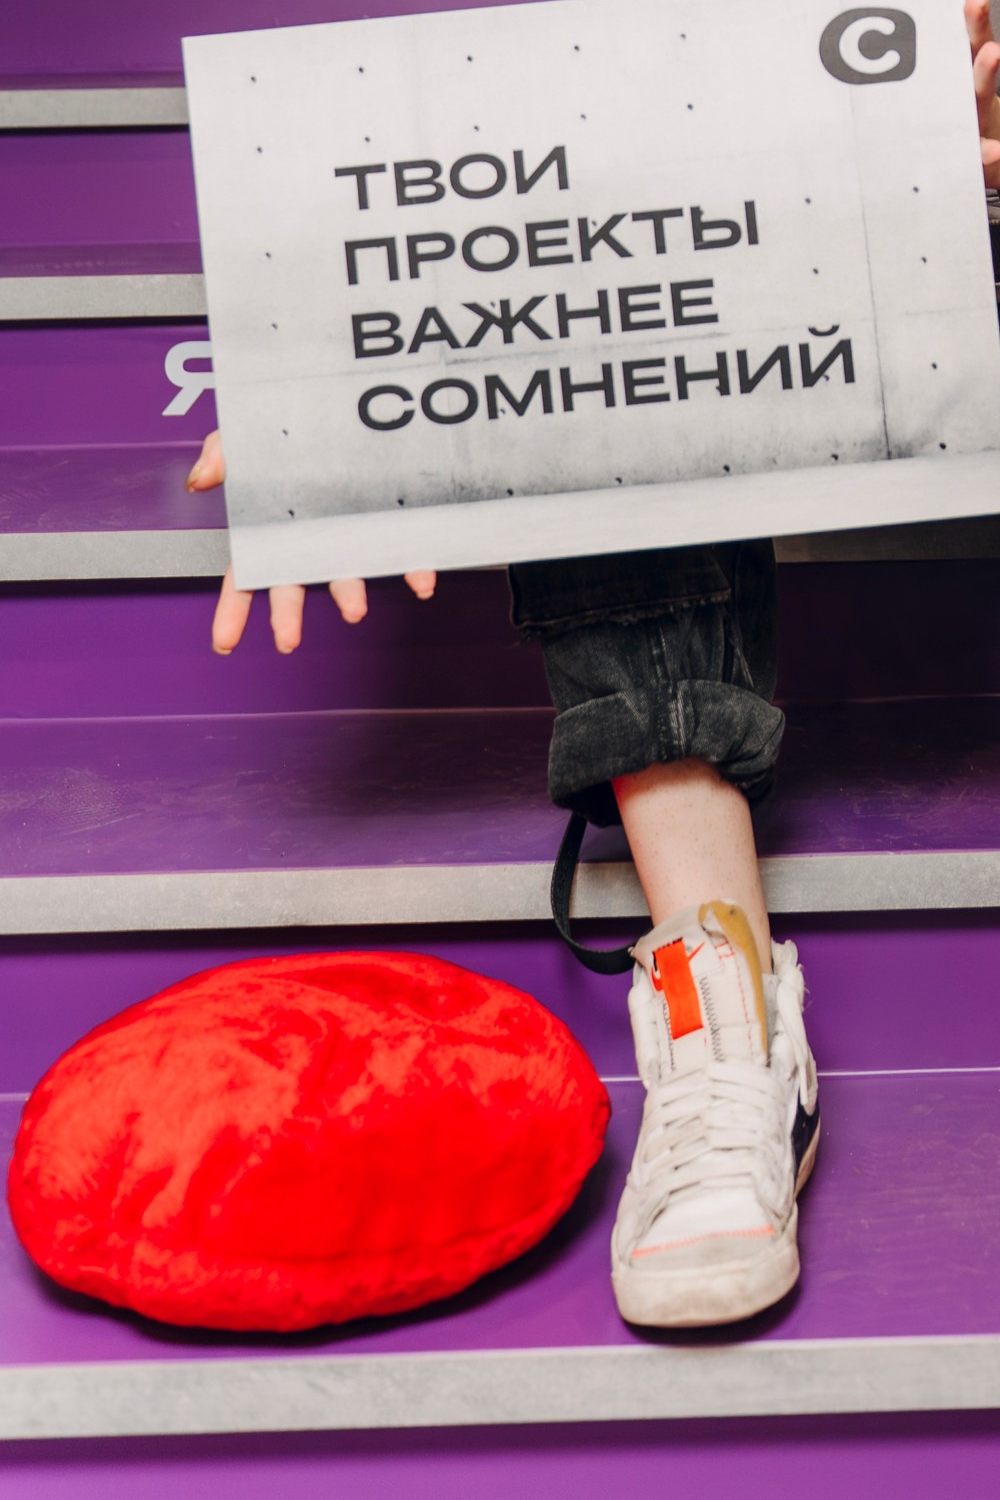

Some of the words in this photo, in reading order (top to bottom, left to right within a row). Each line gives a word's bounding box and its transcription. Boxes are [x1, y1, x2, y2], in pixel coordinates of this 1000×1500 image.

[335, 146, 570, 211] ТВОИ
[345, 200, 759, 286] ПРОЕКТЫ
[352, 278, 719, 360] ВАЖНЕЕ
[358, 325, 856, 432] СОМНЕНИЙ
